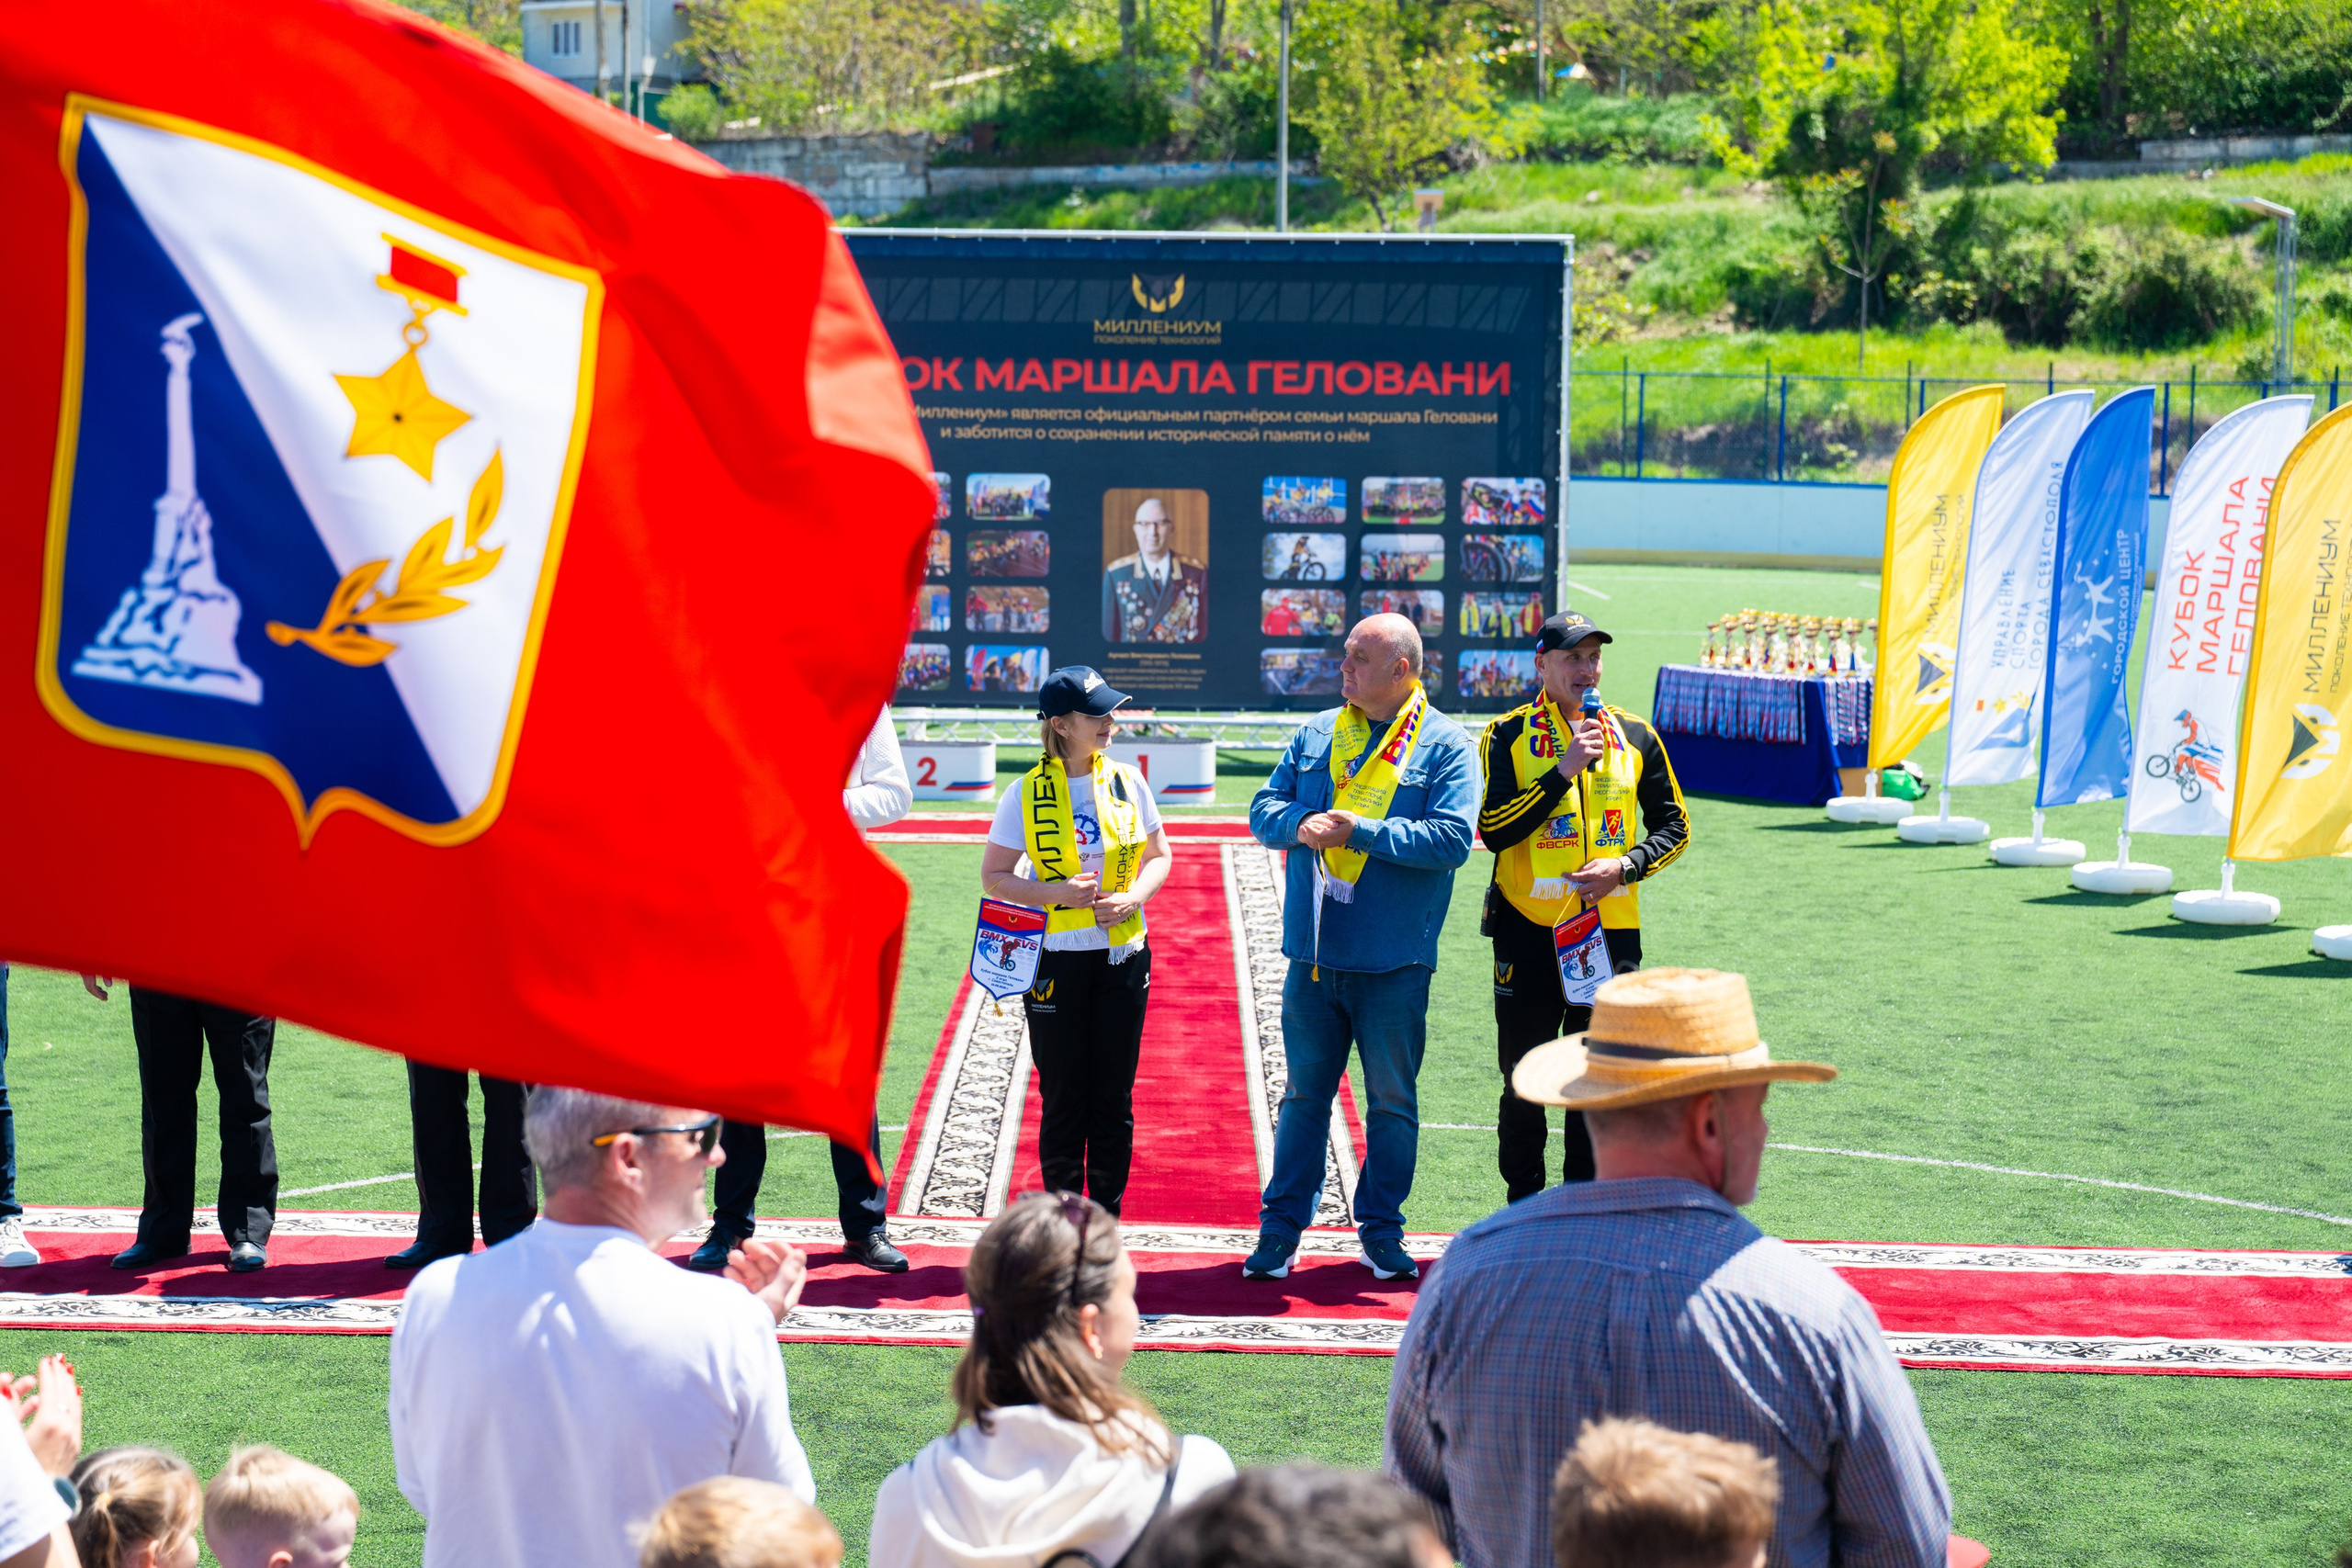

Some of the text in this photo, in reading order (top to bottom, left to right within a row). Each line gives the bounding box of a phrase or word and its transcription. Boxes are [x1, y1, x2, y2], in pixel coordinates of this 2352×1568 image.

[1093, 319, 1222, 334] МИЛЛЕНИУМ
[900, 356, 1511, 396] ОК МАРШАЛА ГЕЛОВАНИ
[940, 423, 1370, 444] и заботится о сохранении исторической памяти о нём
[1012, 408, 1081, 422] является
[1084, 406, 1200, 423] официальным
[1203, 407, 1292, 424] партнёром
[1294, 410, 1344, 423] семьи
[1347, 411, 1421, 425] маршала
[1423, 409, 1498, 424] Геловани
[1925, 493, 1950, 635] МИЛЛЕНИУМ
[2029, 461, 2064, 670] ГОРОДА СЕВАСТОПОЛЯ
[2196, 476, 2249, 673] МАРШАЛА
[1991, 569, 2016, 669] УПРАВЛЕНИЕ
[2111, 528, 2132, 685] ГОРОДСКОЙ ЦЕНТР
[2167, 549, 2206, 671] КУБОК
[2303, 519, 2341, 694] МИЛЛЕНИУМ
[2009, 601, 2031, 670] СПОРТА
[2330, 612, 2350, 694] ПОКОЛЕНИЕ
[916, 756, 938, 786] 2
[1136, 754, 1149, 782] 1
[1536, 839, 1580, 850] ФВСРК
[1594, 837, 1625, 847] ФТРК
[979, 930, 1010, 944] BMX
[1561, 948, 1581, 965] BMX
